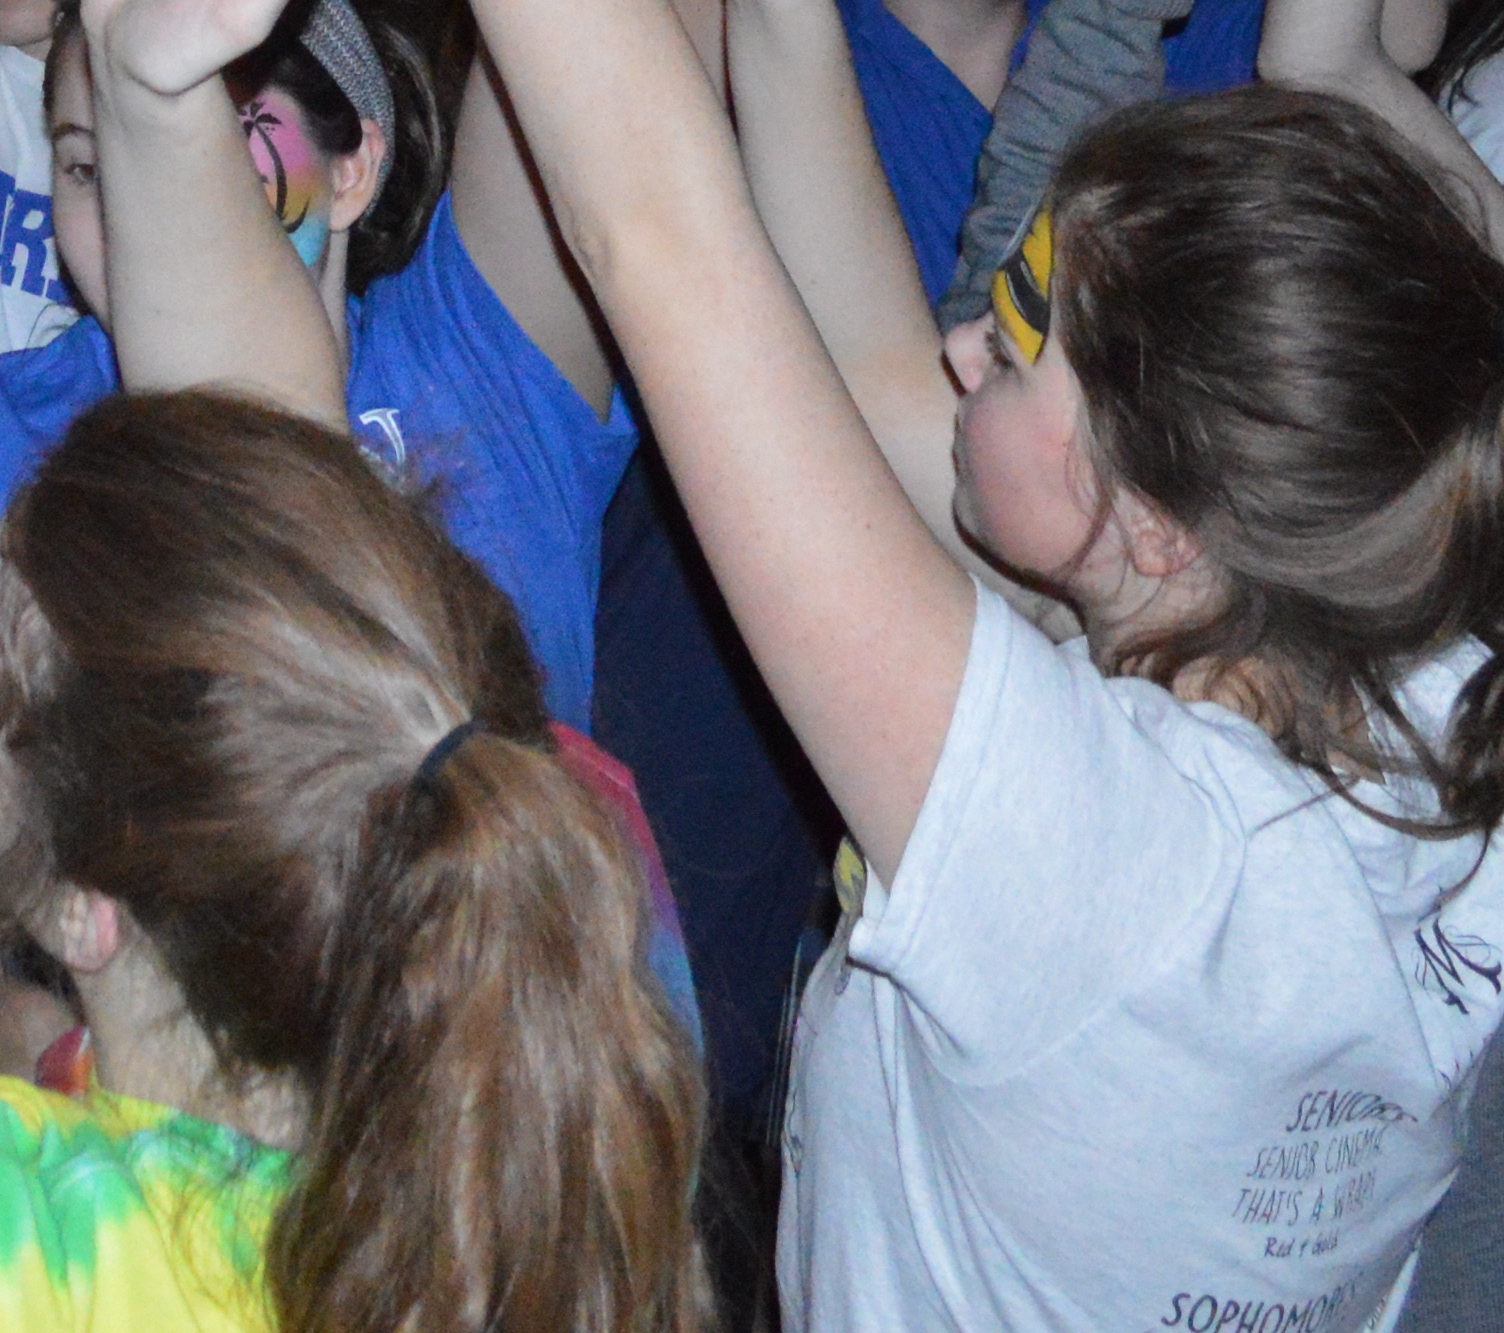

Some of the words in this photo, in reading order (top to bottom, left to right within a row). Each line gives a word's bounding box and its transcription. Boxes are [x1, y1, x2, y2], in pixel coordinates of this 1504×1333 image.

[1246, 1140, 1319, 1181] SENIOR
[1231, 1187, 1303, 1226] THAT'S
[1309, 1186, 1325, 1224] A
